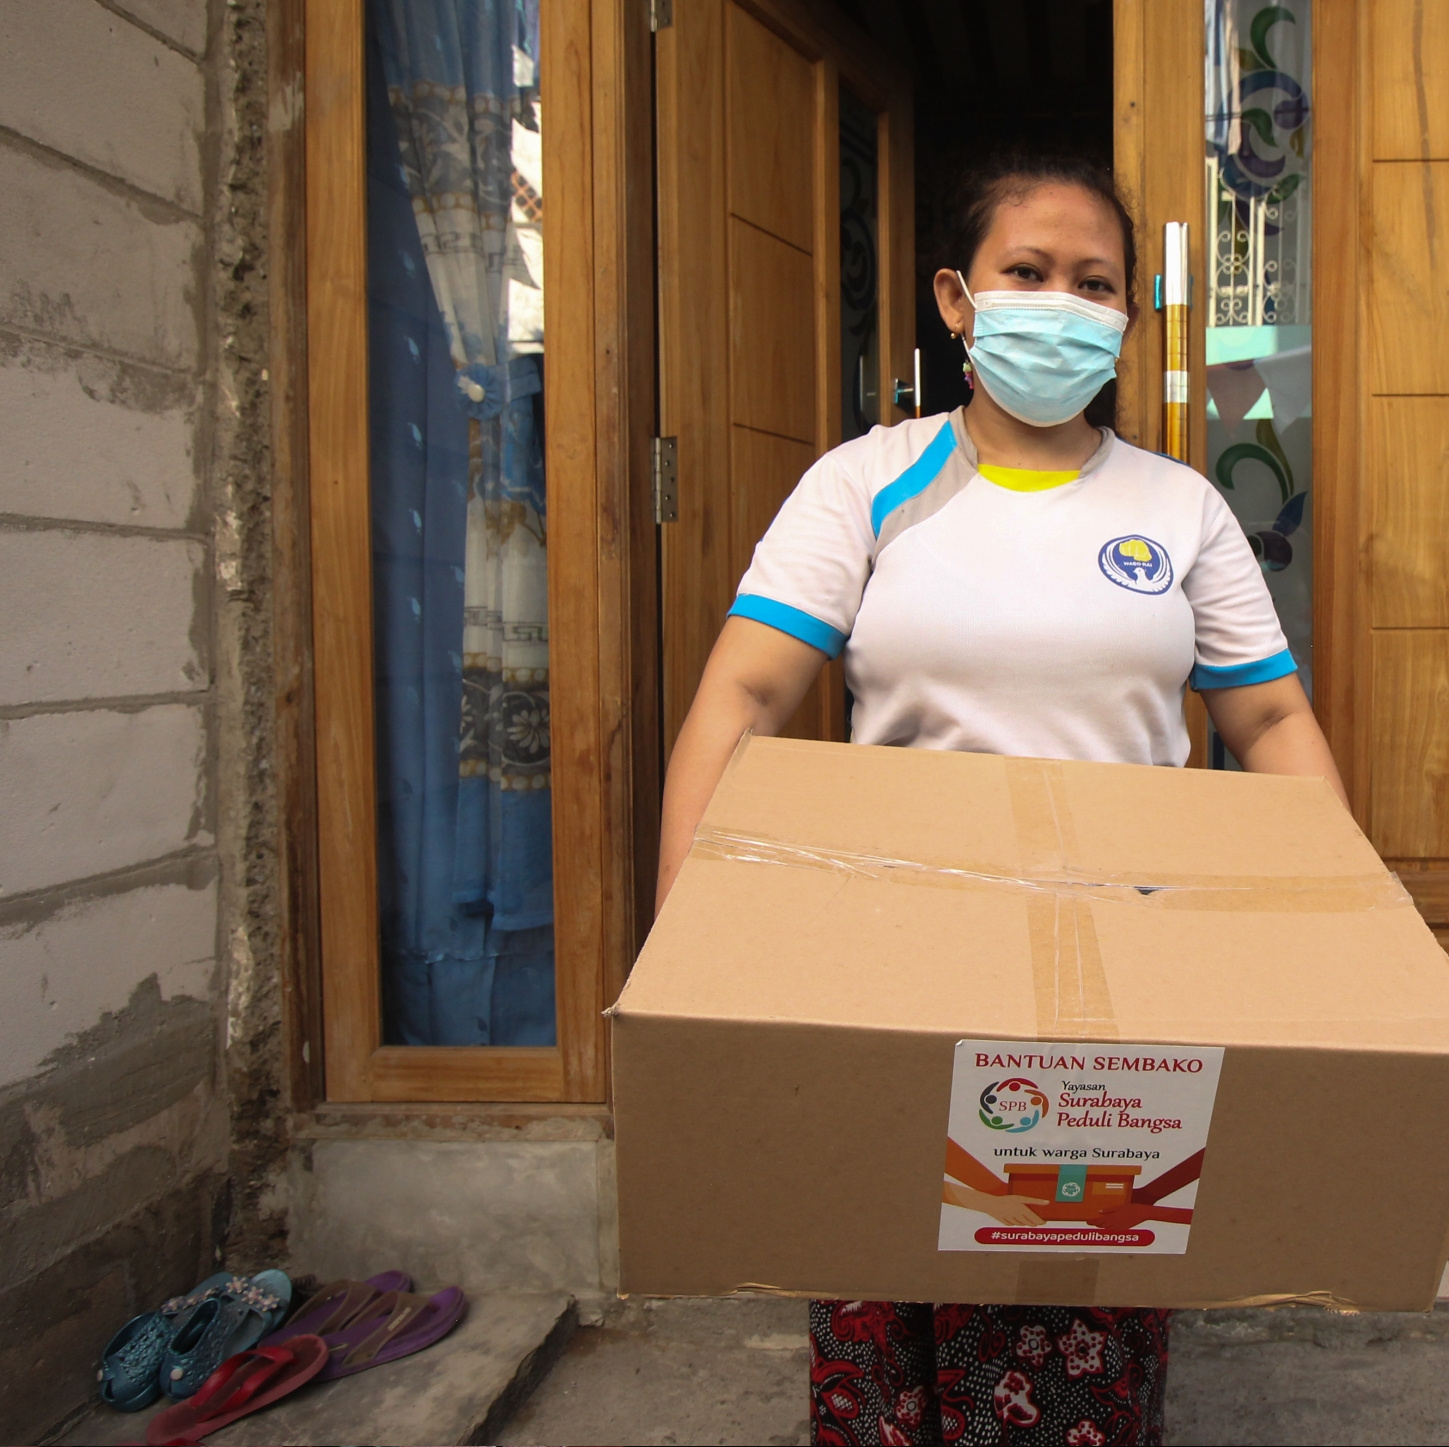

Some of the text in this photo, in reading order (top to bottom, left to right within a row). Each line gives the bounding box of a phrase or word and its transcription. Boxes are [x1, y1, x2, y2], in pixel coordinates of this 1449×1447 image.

[975, 1053, 1203, 1073] BANTUAN SEMBAKO
[1062, 1080, 1106, 1094] Yayasan
[999, 1100, 1027, 1112] SPB
[1058, 1092, 1142, 1112] Surabaya
[1056, 1112, 1182, 1133] Peduli Bangsa
[994, 1147, 1160, 1161] untuk warga Surabaya
[991, 1231, 1139, 1243] #surabayapedulibangsa
